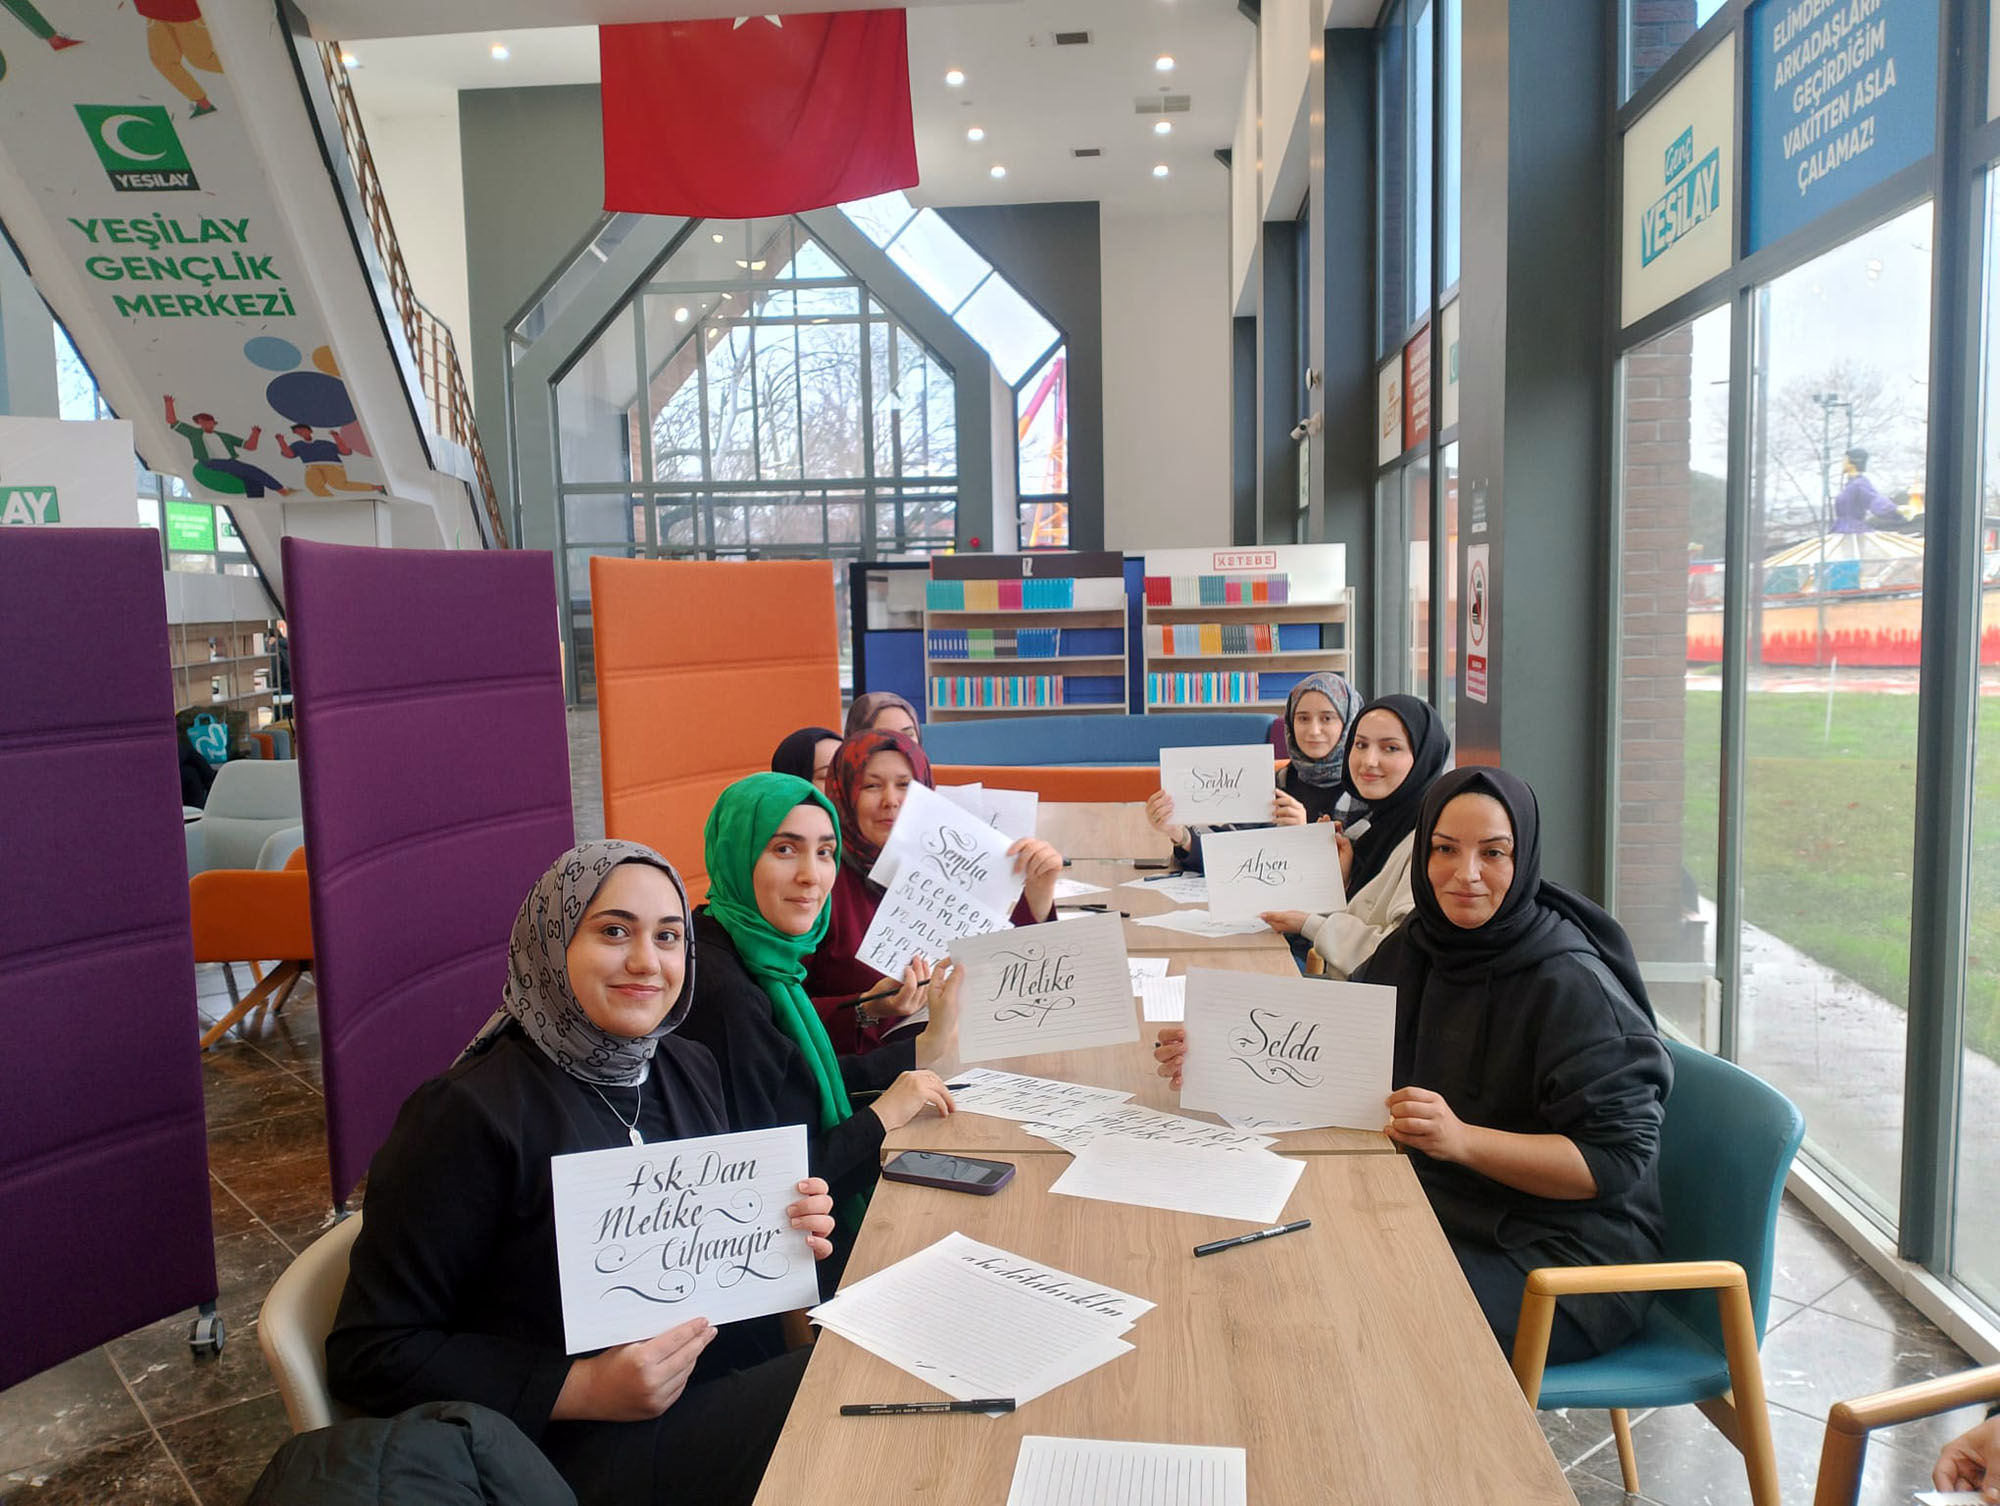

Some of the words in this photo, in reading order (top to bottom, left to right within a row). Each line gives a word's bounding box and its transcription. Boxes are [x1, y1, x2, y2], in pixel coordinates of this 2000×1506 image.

[1792, 19, 1886, 114] GEÇİRDİĞİM
[1783, 90, 1849, 160] VAKİTTEN
[1852, 57, 1897, 114] ASLA
[1798, 116, 1875, 197] ÇALAMAZ!
[115, 173, 191, 189] YEŞİLAY
[67, 212, 249, 250] YEŞİLAY
[1642, 158, 1718, 260] YEŞİLAY
[85, 251, 281, 287] GENÇLİK
[112, 287, 296, 317] MERKEZİ
[0, 491, 52, 524] AY
[1217, 555, 1272, 566] KETEBE
[989, 954, 1075, 1001] Melike
[1236, 1008, 1321, 1062] Selda
[661, 1225, 781, 1282] Cihangir
